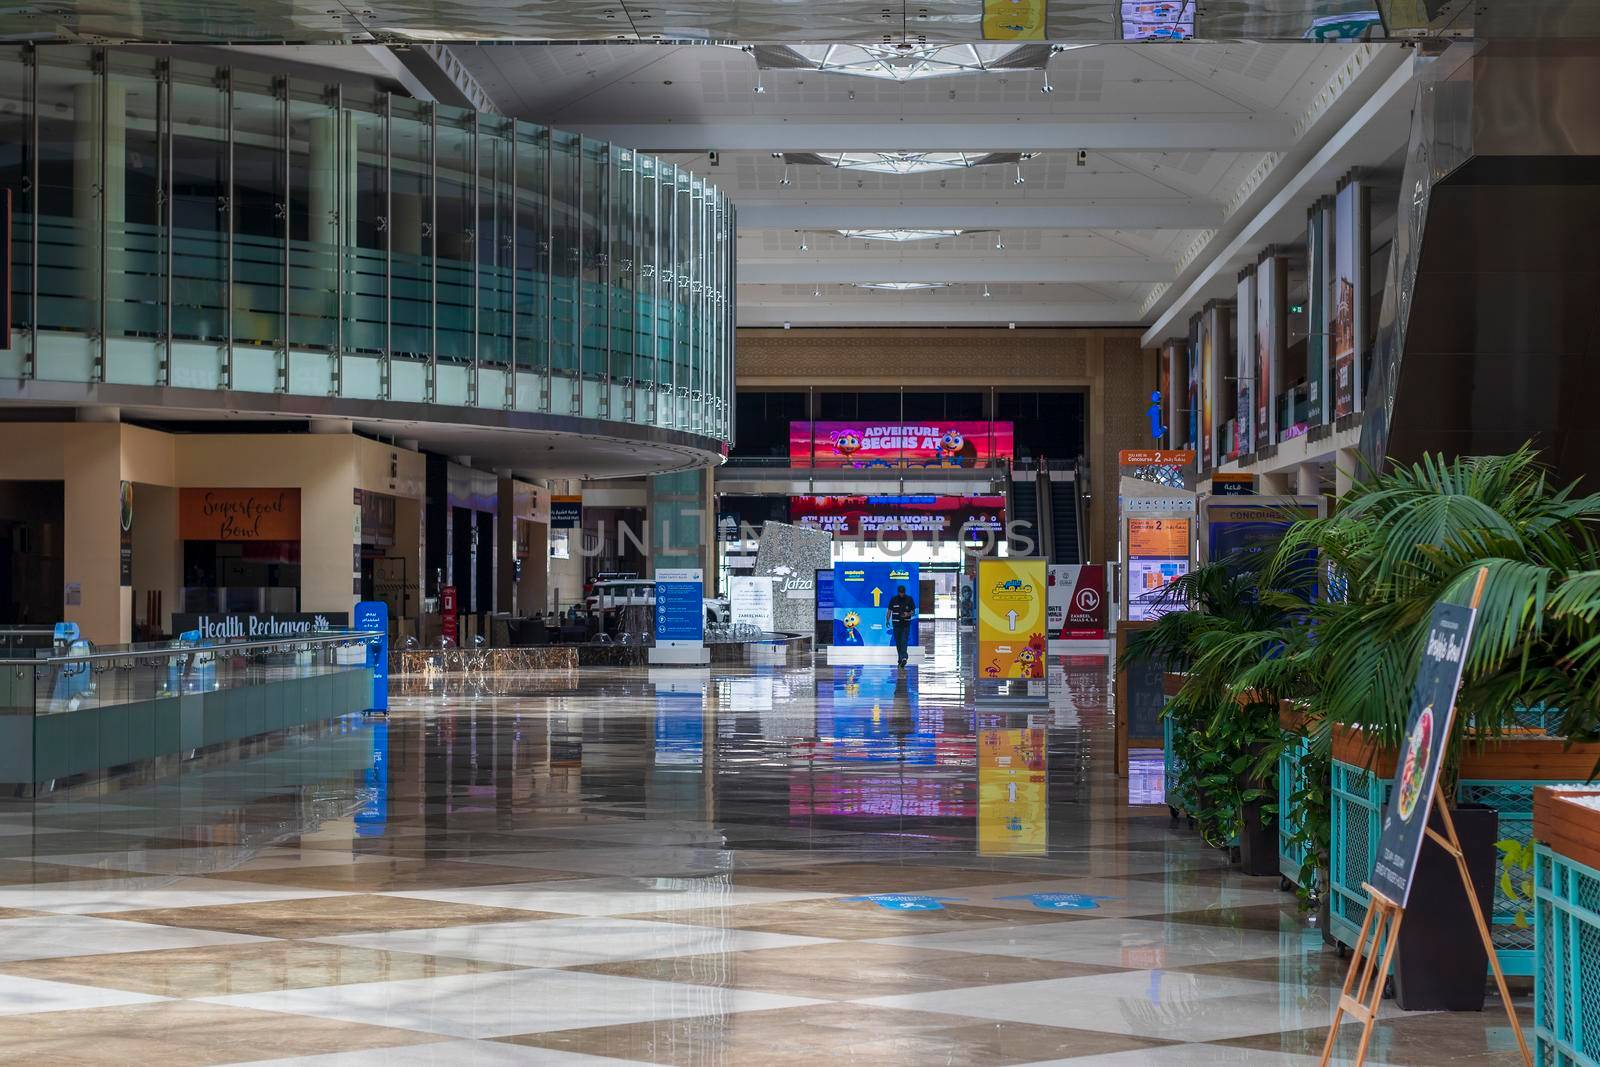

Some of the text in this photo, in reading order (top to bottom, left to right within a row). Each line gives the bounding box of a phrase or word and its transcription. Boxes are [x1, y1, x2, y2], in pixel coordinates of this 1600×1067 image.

[864, 427, 939, 437] ADVENTURE
[861, 437, 942, 450] BEGINS AT
[1154, 452, 1162, 463] 2
[203, 491, 286, 518] Superfood
[800, 515, 848, 523] 8TH JULY
[860, 515, 945, 523] DUBAI WORLD
[221, 515, 262, 539] Bowl
[823, 523, 849, 531] AUG
[863, 523, 944, 531] TRADE CENTER
[1155, 520, 1162, 530] 2
[198, 615, 246, 639] Health
